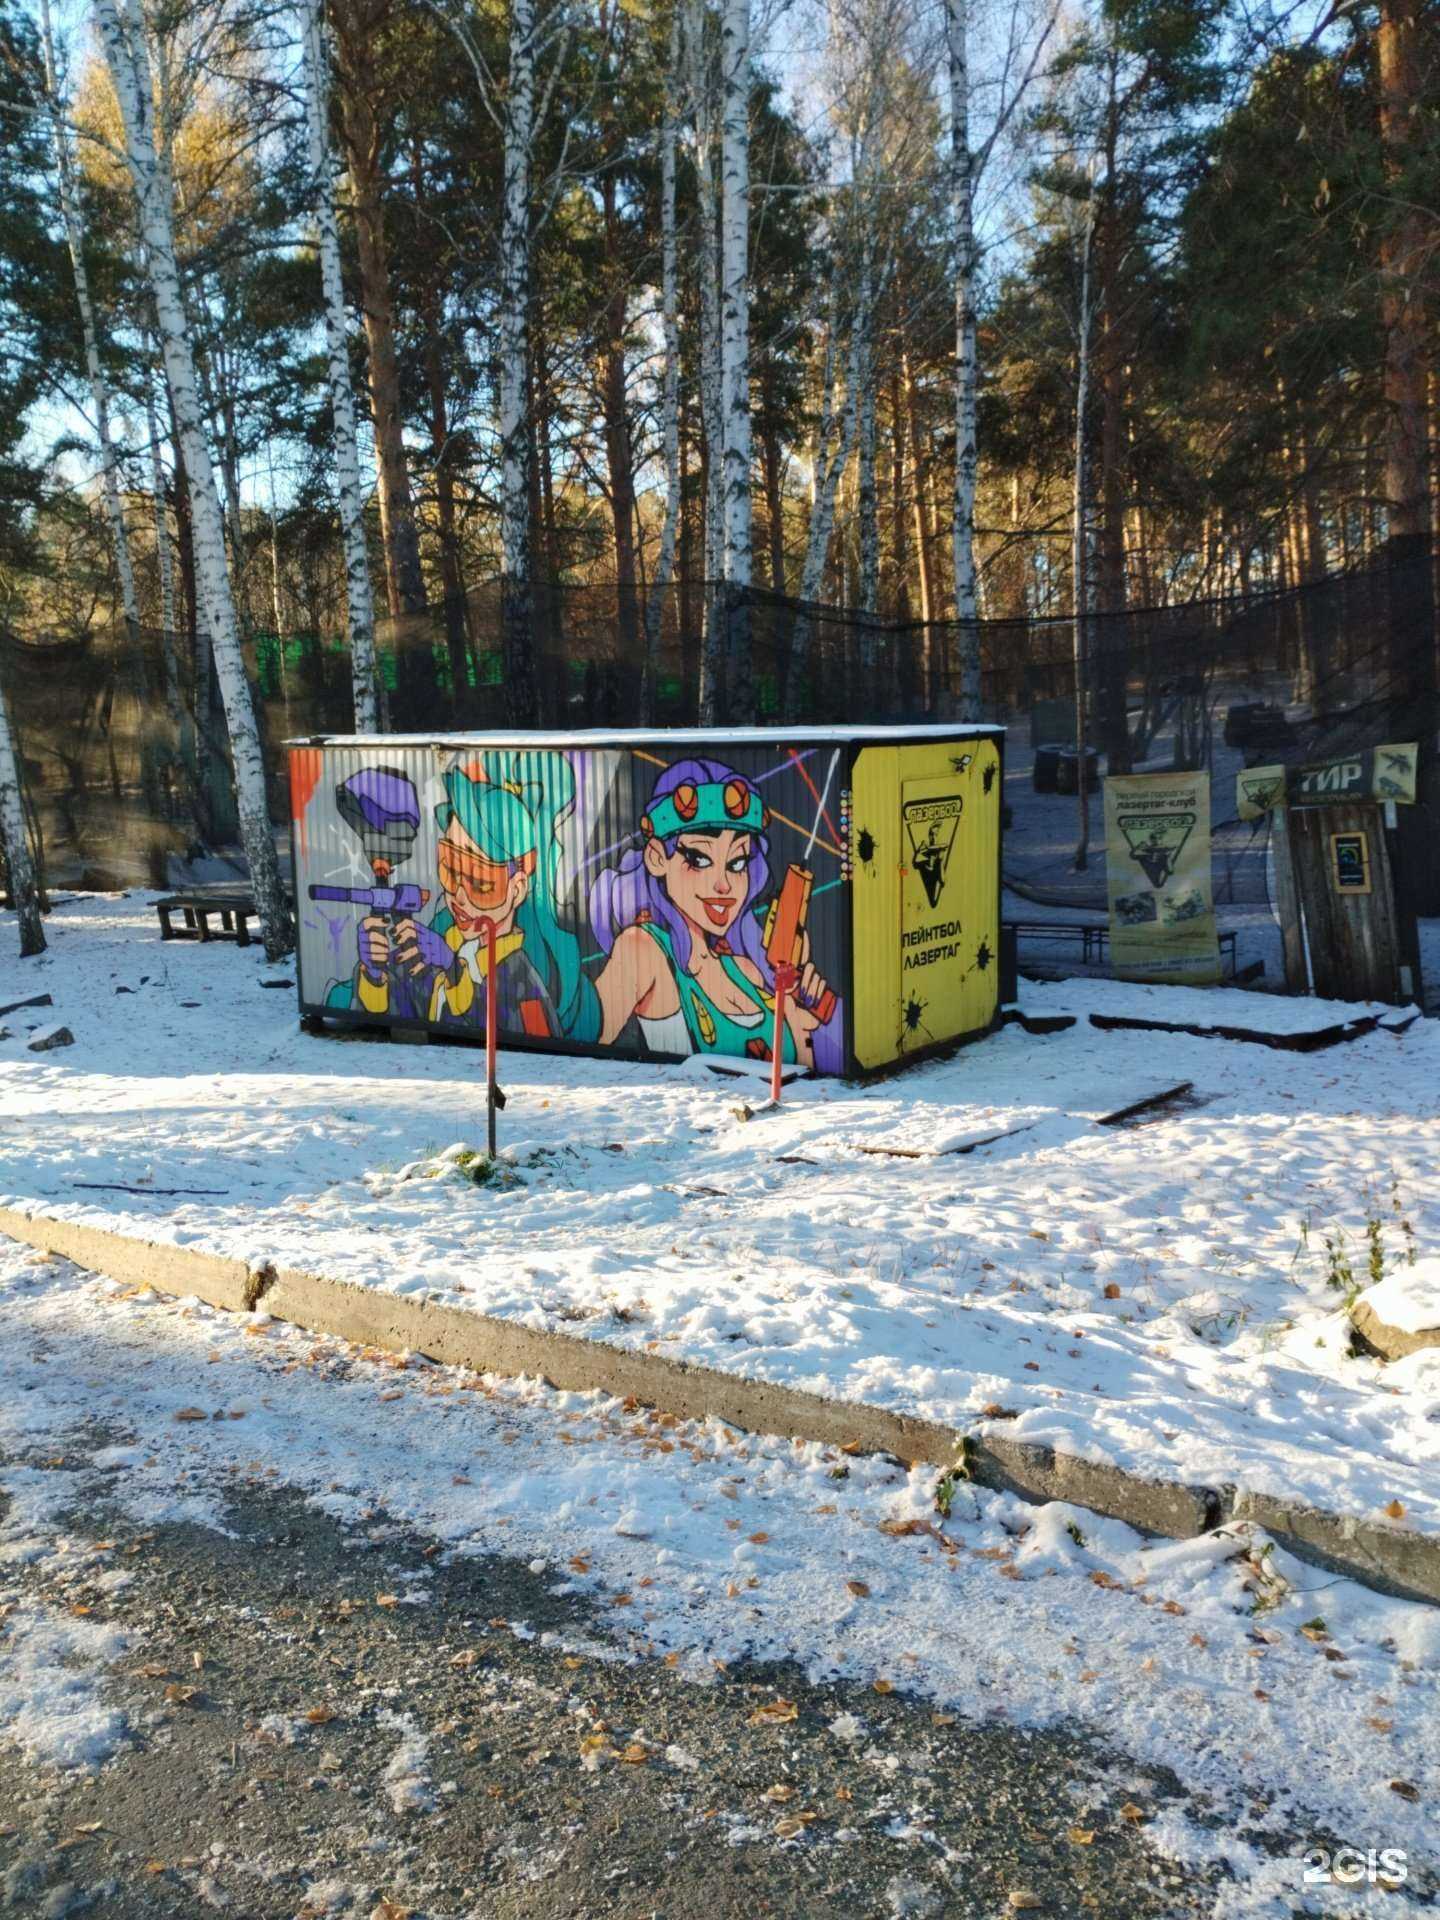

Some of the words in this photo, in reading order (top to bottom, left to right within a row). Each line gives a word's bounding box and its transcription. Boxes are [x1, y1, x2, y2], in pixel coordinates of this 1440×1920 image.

[1302, 764, 1362, 792] ТИР
[902, 920, 962, 948] ПЕЙНТБОЛ
[904, 942, 960, 970] ЛАЗЕРТАГ
